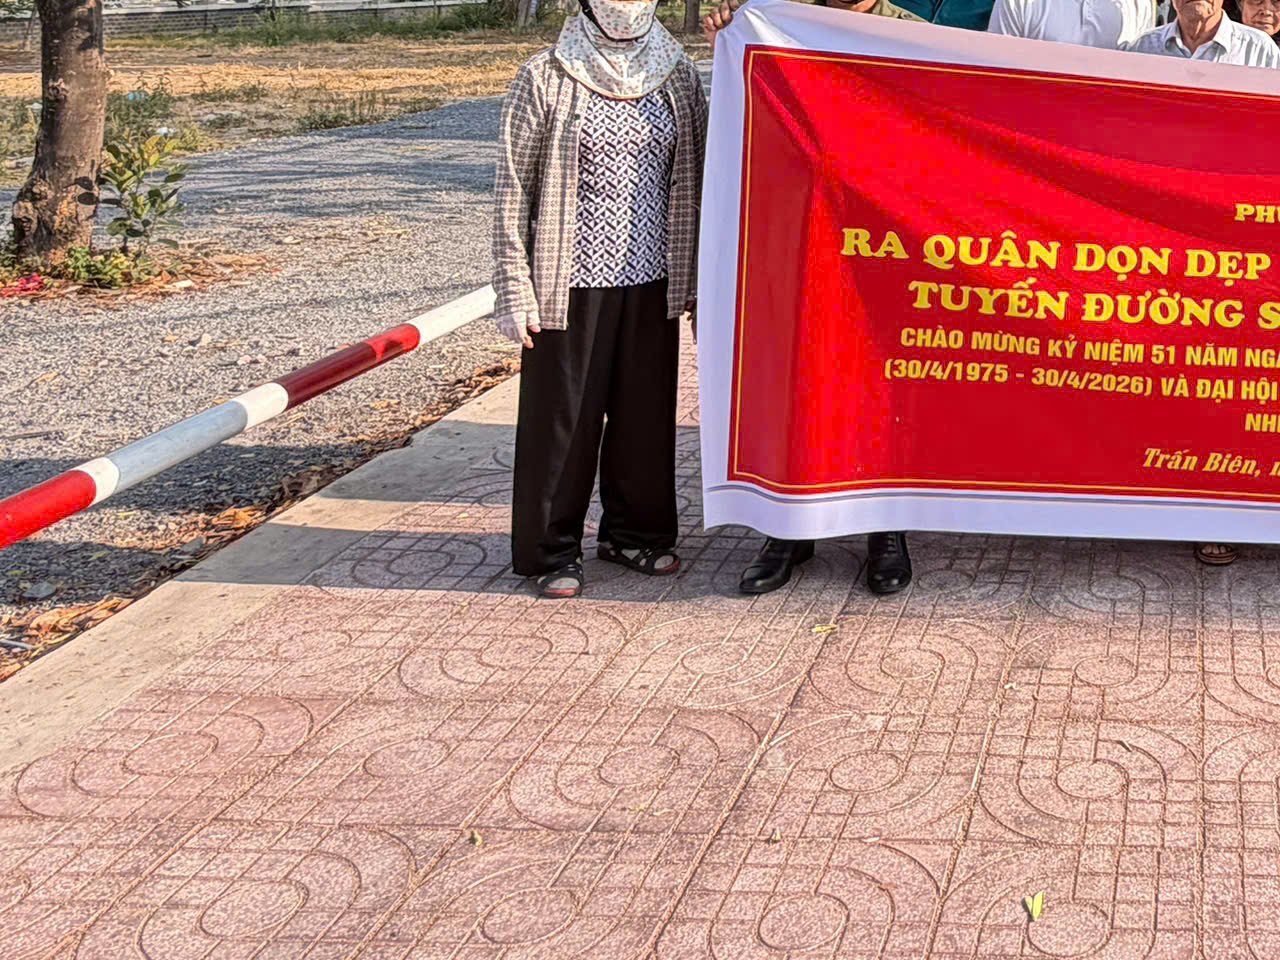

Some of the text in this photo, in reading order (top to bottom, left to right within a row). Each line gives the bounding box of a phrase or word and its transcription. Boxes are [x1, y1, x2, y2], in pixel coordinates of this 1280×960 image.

[840, 228, 909, 259] RA
[923, 230, 1061, 270] QUÂN
[1072, 243, 1172, 282] DỌN
[1184, 249, 1271, 287] DẸP
[908, 277, 1070, 320] TUYẾN
[1081, 288, 1245, 328] ĐƯỜNG
[901, 325, 964, 349] CHÀO
[971, 331, 1040, 355] MỪNG
[1048, 339, 1077, 358] KỶ
[1084, 339, 1144, 363] NIỆM
[1151, 344, 1176, 365] 51
[1185, 343, 1238, 367] NĂM
[885, 359, 1008, 382] (30/4/1975
[1031, 368, 1152, 396] 30/4/2026)
[1161, 374, 1189, 397] VÀ
[1196, 379, 1234, 403] ĐẠI
[1241, 377, 1278, 405] HỘI
[1143, 448, 1198, 471] Trấn
[1202, 453, 1261, 477] Biên,
